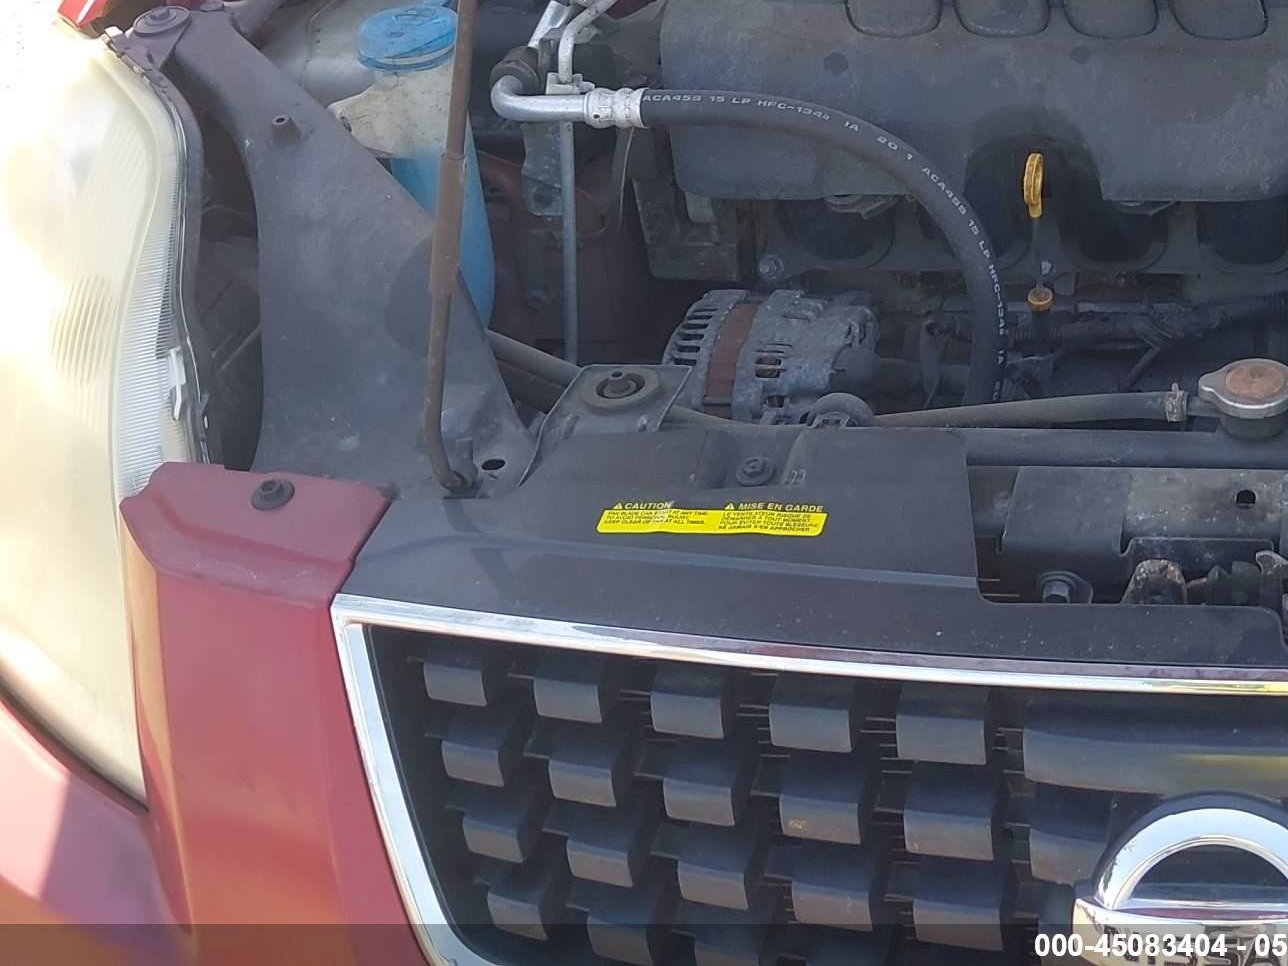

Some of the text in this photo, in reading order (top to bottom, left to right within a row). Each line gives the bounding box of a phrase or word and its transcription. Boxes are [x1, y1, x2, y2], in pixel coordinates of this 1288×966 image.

[709, 95, 726, 103] 15
[732, 96, 751, 105] LP
[757, 99, 831, 121] HFC-134a
[624, 502, 672, 510] CAUTION
[738, 502, 824, 513] MISE EN GARDE
